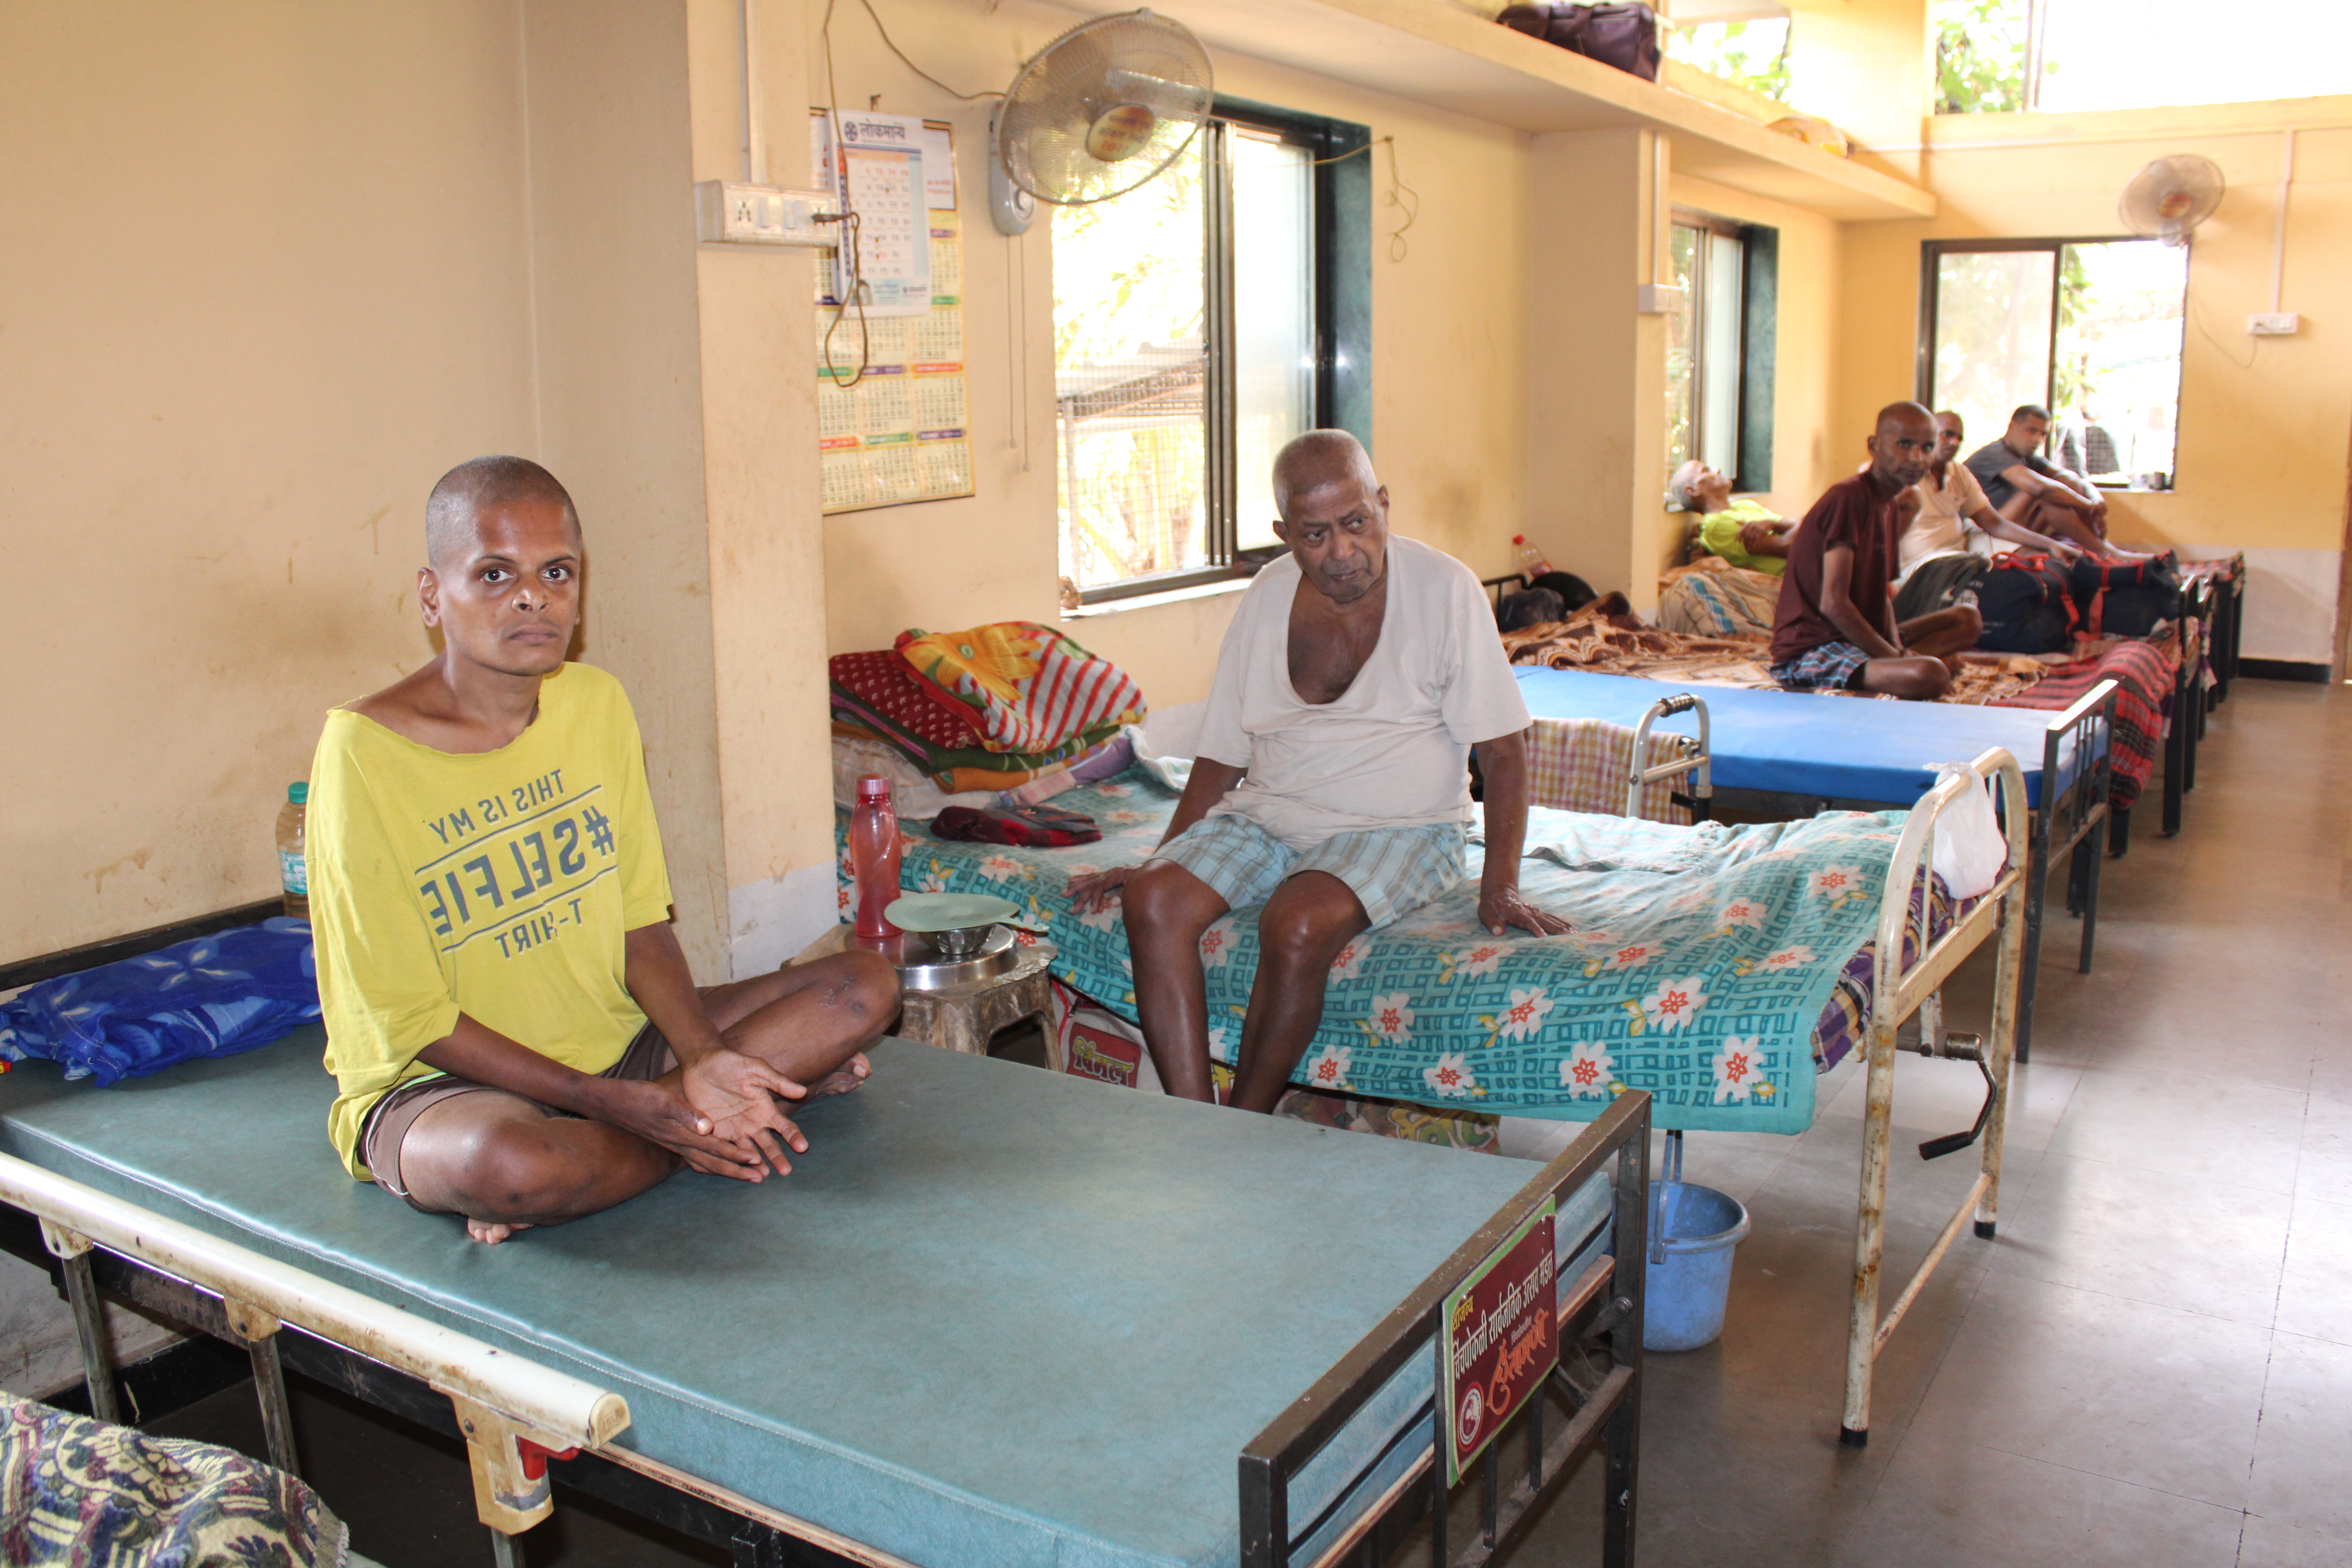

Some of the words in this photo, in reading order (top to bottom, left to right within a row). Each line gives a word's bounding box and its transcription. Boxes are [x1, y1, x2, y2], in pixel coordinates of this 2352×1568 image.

[1454, 1309, 1488, 1380] चिंचपोकळी
[1488, 1282, 1522, 1345] सार्वजनिक
[1523, 1267, 1539, 1308] उत्सव
[1539, 1247, 1553, 1287] मंडळ
